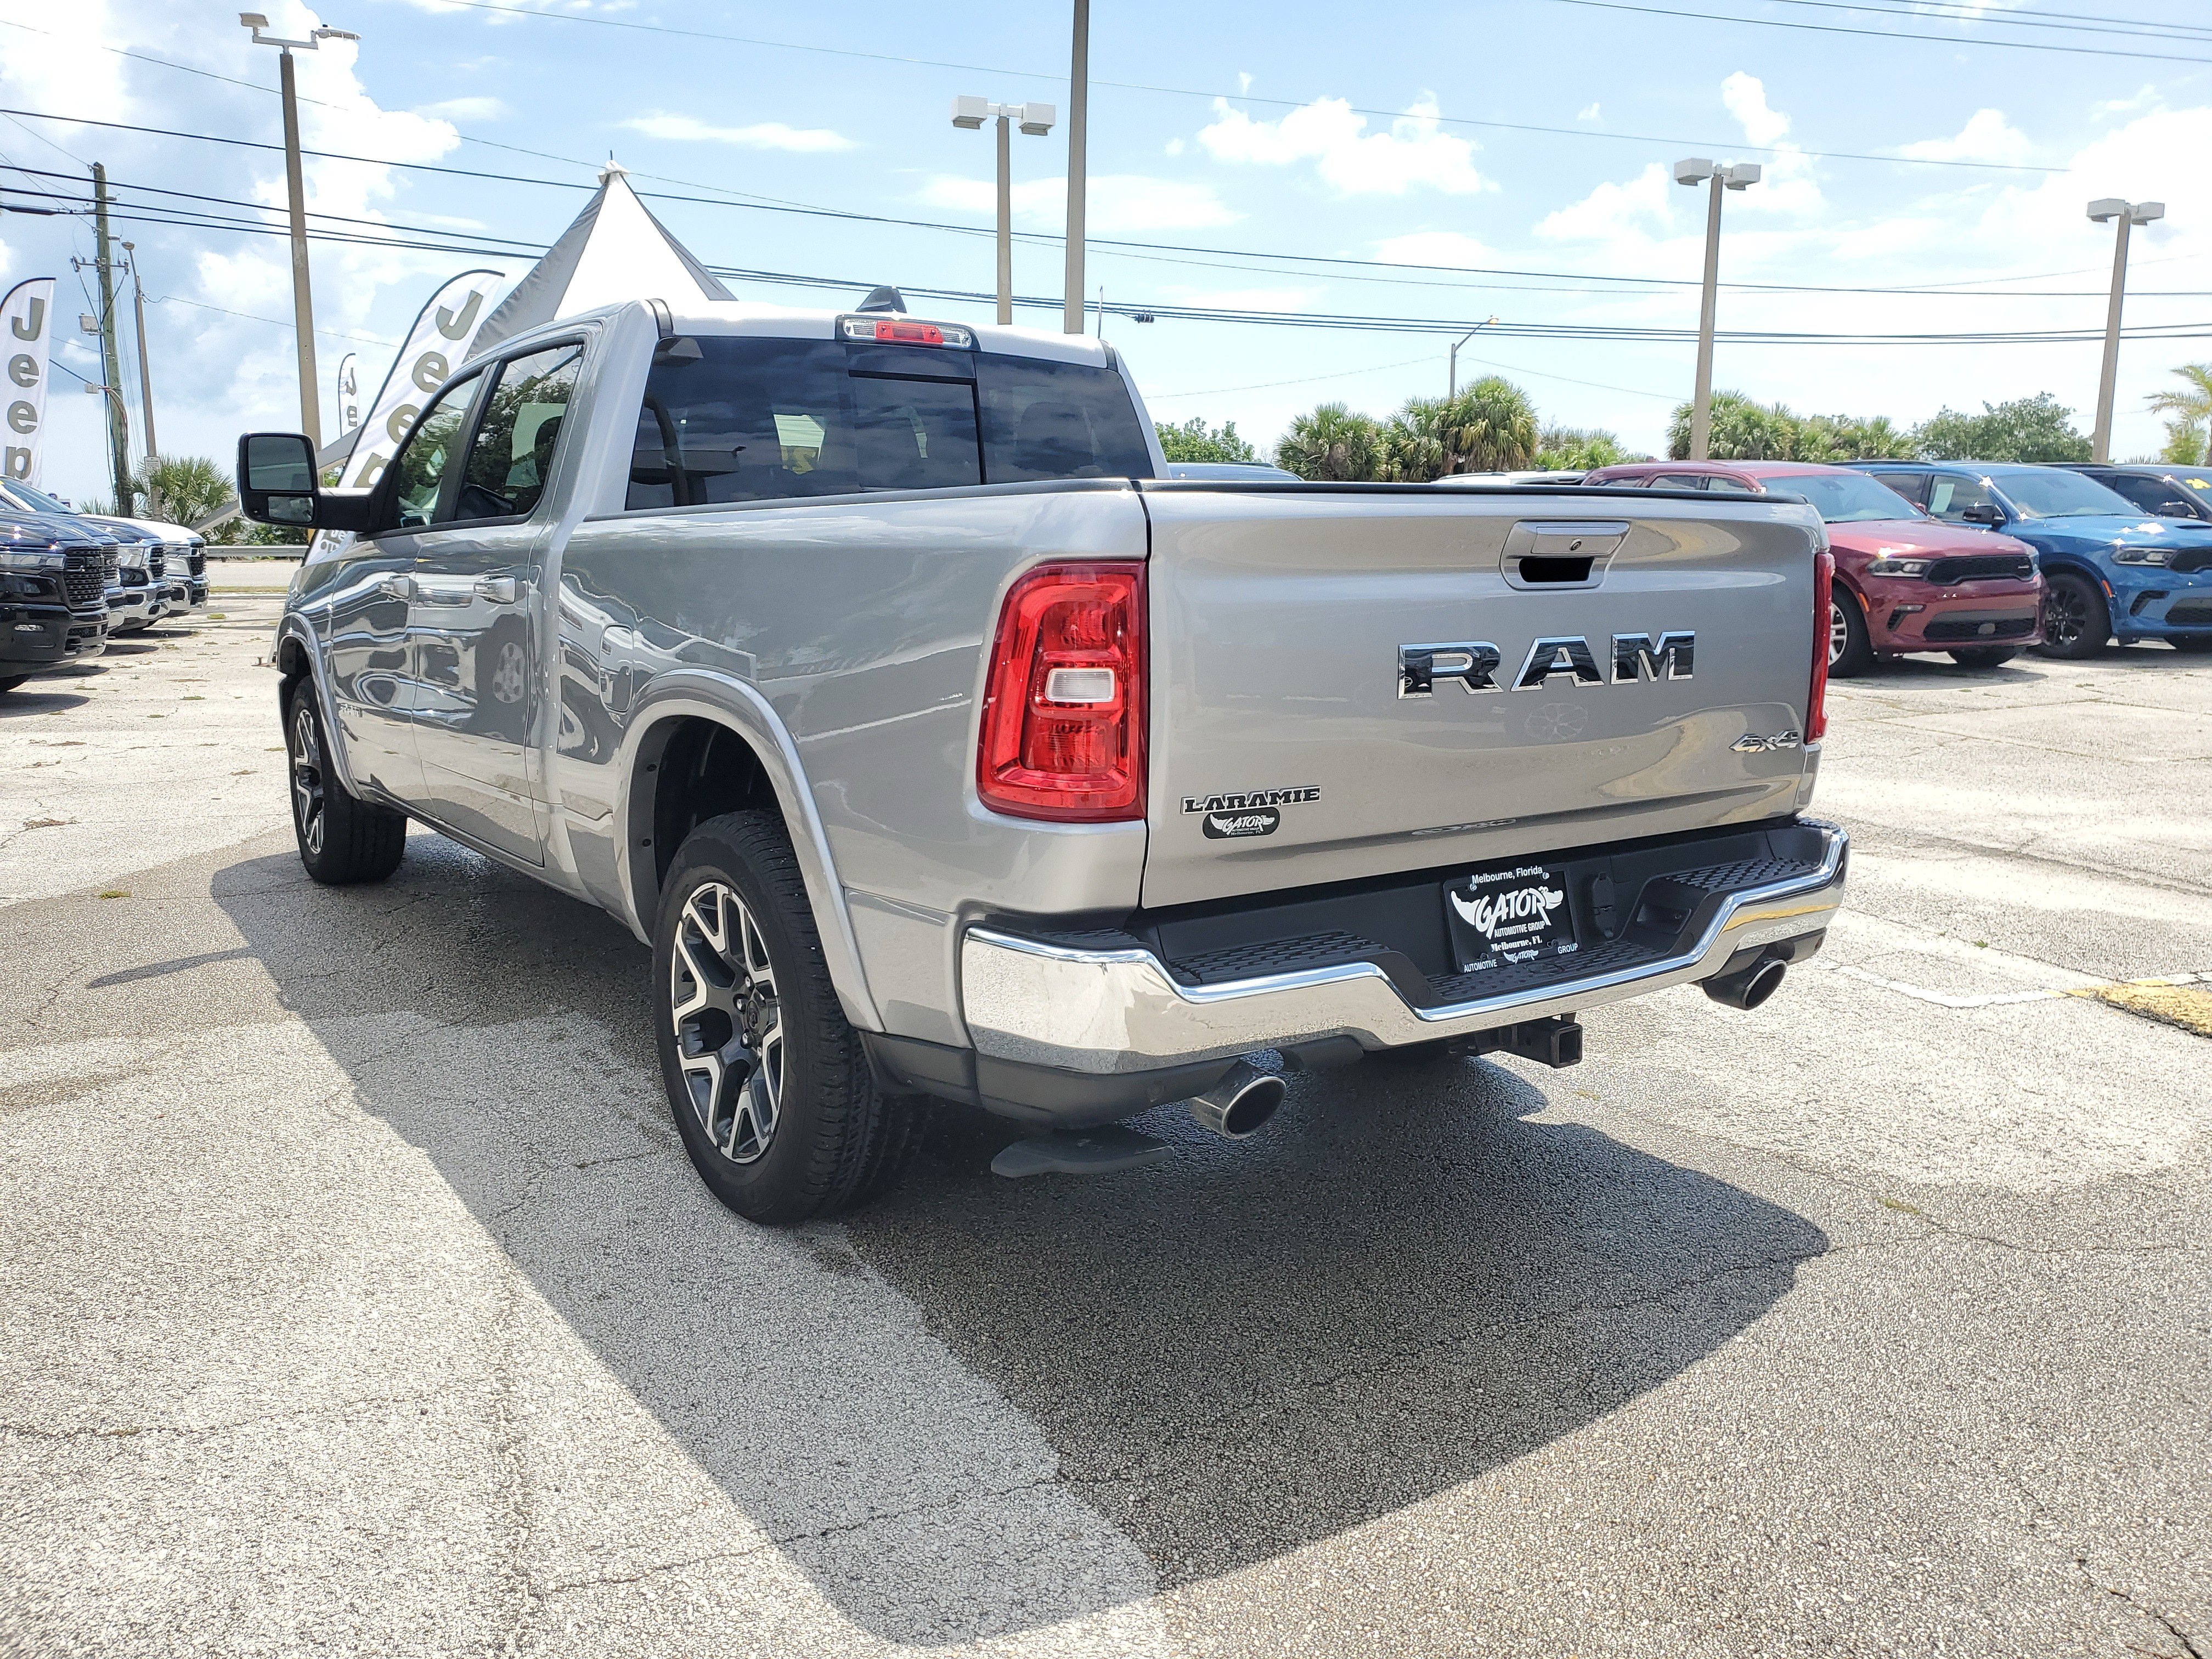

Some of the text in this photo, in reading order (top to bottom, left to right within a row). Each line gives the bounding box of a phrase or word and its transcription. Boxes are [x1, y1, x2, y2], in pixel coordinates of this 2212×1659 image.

[5, 297, 45, 480] Jeep
[1397, 630, 1696, 700] RAM
[1729, 730, 1799, 753] 4x4
[1180, 785, 1322, 815] LARAMIE
[1222, 815, 1264, 836] GATOR
[1471, 865, 1543, 885] Melbourne, Florida
[1475, 888, 1551, 940] GATOR
[1494, 921, 1545, 938] AUTOMOTIVE GROUP
[1491, 935, 1543, 952] Melbourne, FL
[1464, 943, 1578, 973] AUTOMOTIVE GATOR GROUP
